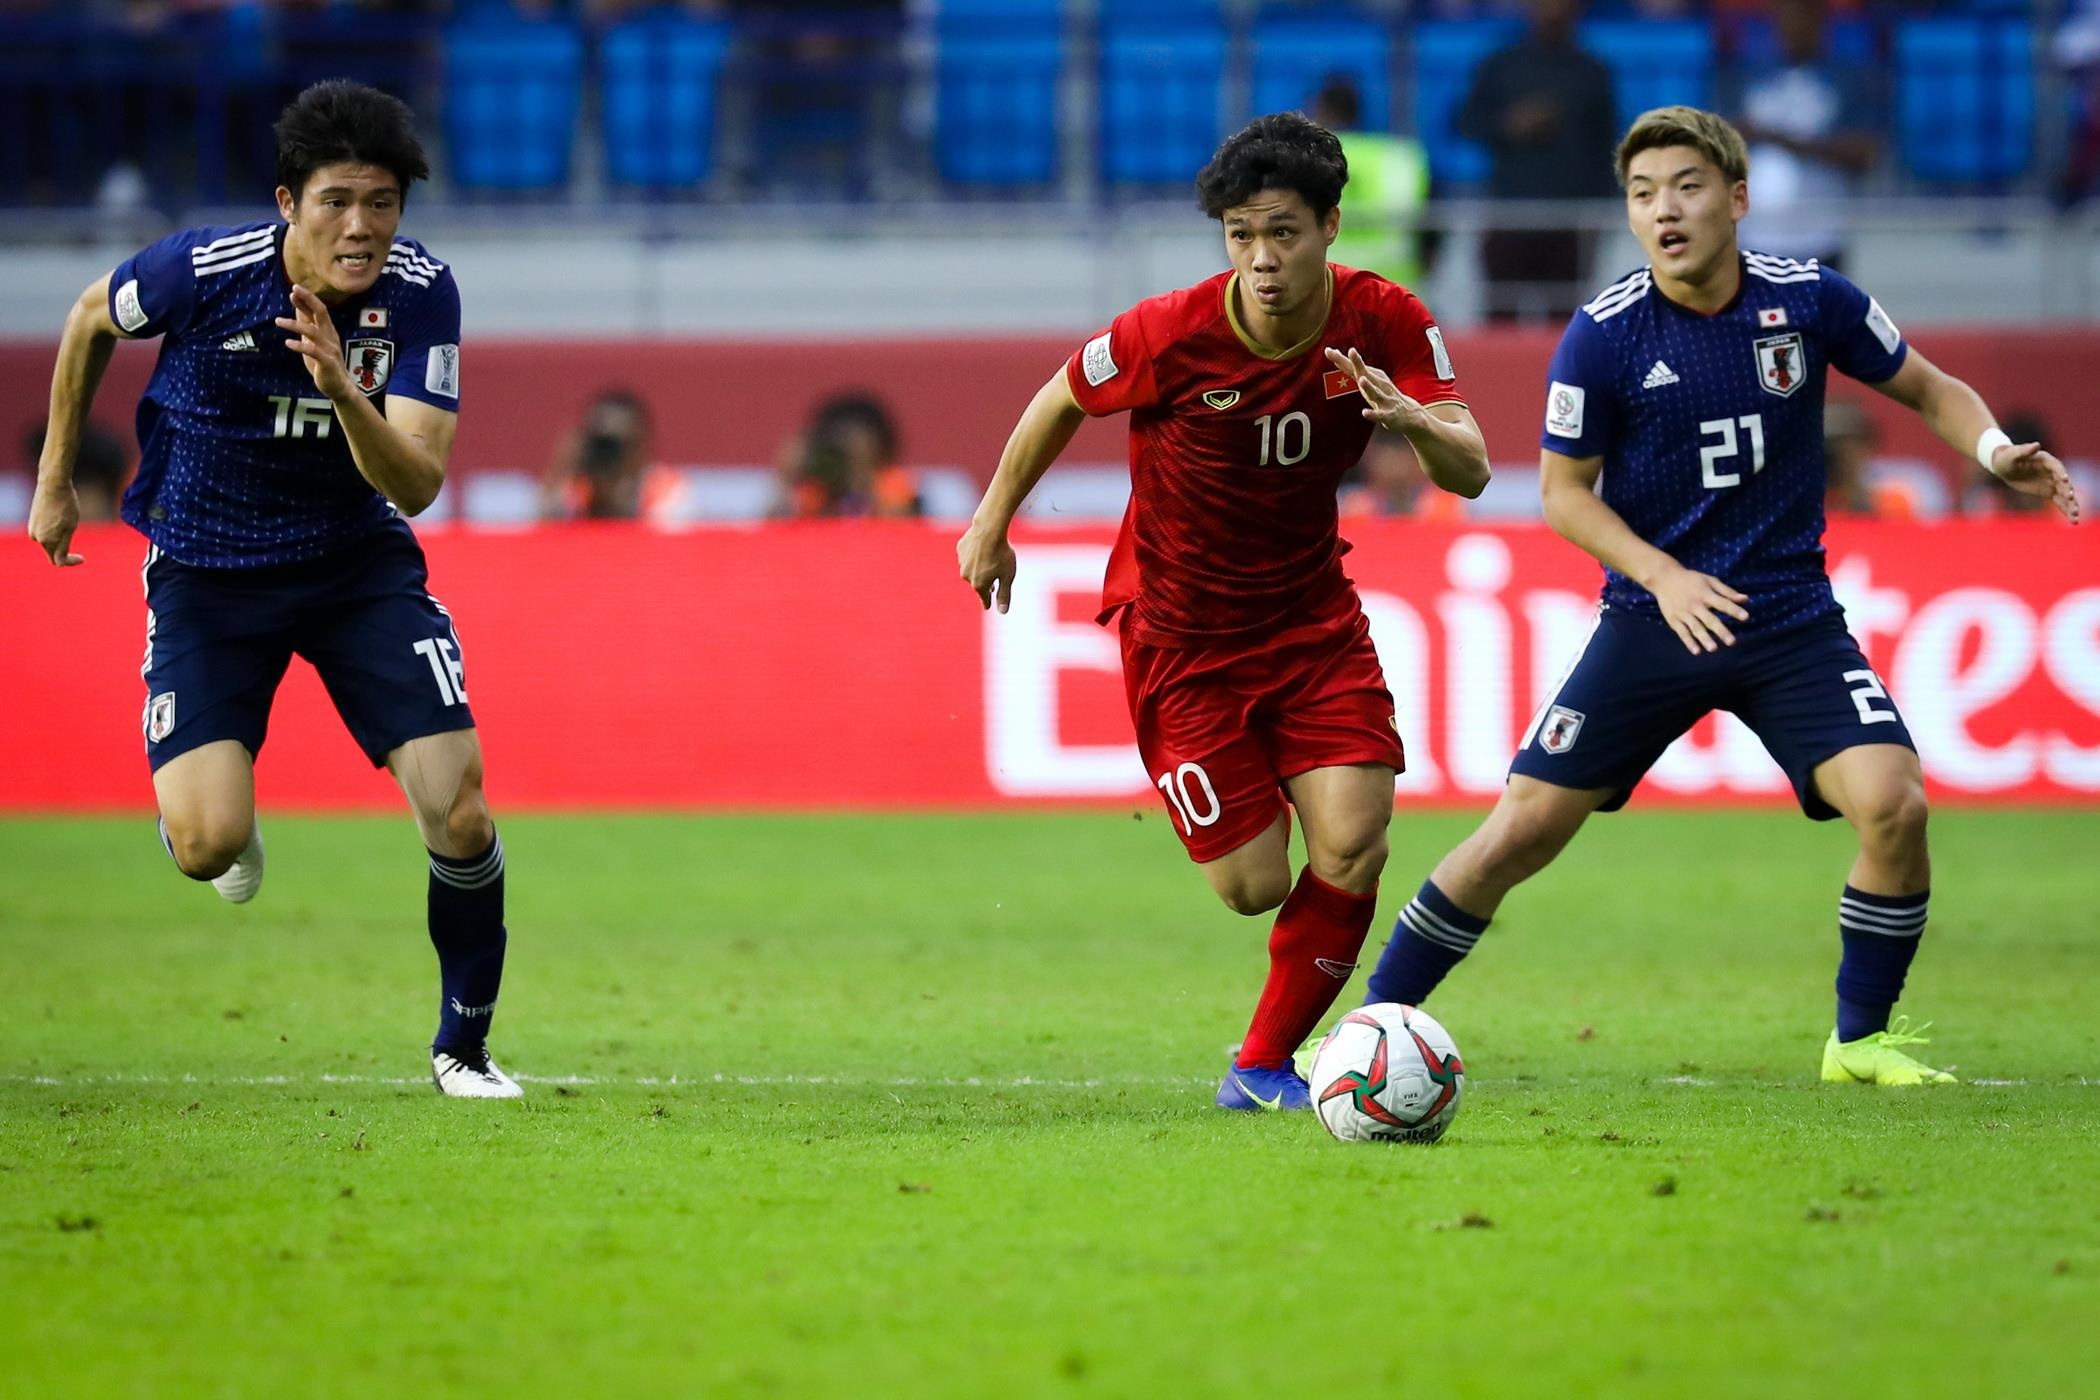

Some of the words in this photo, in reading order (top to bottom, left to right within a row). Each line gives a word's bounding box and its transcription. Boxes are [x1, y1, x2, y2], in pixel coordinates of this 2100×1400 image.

[360, 340, 384, 348] JAPAN
[1642, 373, 1681, 389] adidas
[1254, 411, 1311, 467] 10
[1700, 413, 1764, 489] 21
[413, 637, 469, 707] 16
[1842, 669, 1897, 724] 2
[1158, 762, 1220, 837] 10
[1370, 1121, 1442, 1143] molten
